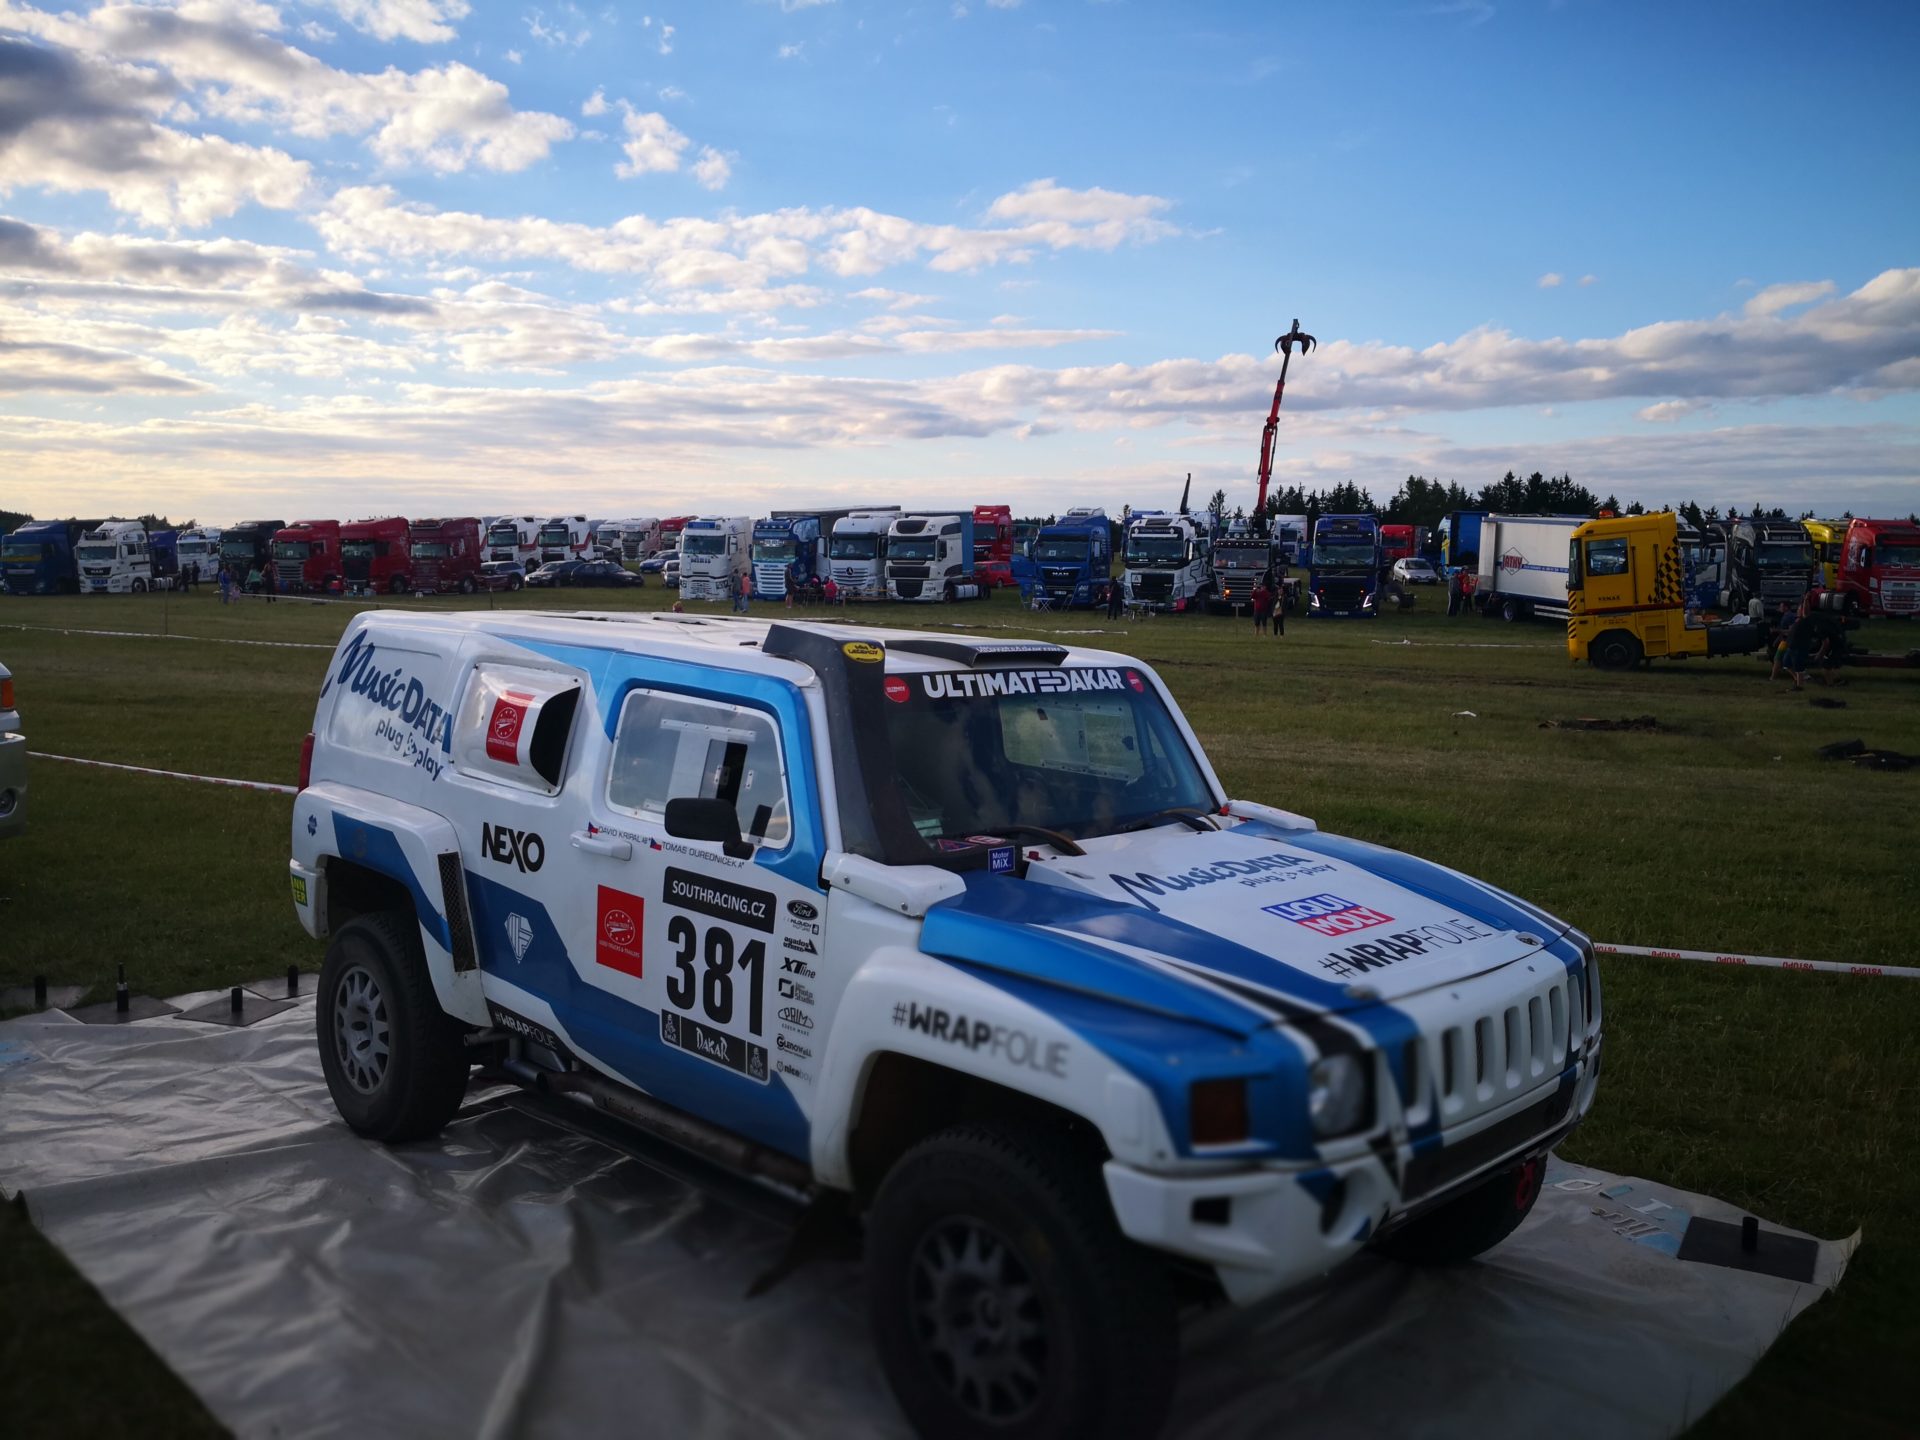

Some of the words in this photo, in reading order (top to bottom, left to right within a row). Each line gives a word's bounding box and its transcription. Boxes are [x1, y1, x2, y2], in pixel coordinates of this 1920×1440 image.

[375, 718, 404, 750] plug
[413, 749, 445, 781] play
[598, 825, 617, 837] DAVID
[482, 821, 545, 873] NEXO
[662, 841, 687, 854] TOMAS
[992, 851, 1010, 859] Motor
[1110, 853, 1314, 913] MusicDATA
[1239, 871, 1284, 888] plug
[1299, 863, 1338, 879] play
[671, 879, 766, 919] SOUTHRACING.CZ
[793, 903, 813, 918] Ford
[1268, 895, 1357, 921] LIQUI
[1306, 906, 1388, 935] MOLY
[1317, 919, 1493, 978] #WRAPFOLIE
[666, 915, 766, 1037] 381
[780, 957, 816, 978] XTline
[495, 1011, 557, 1049] #WRAPFOLIE
[784, 1007, 808, 1026] PRIM
[892, 999, 1070, 1079] #WRAPFOLIE
